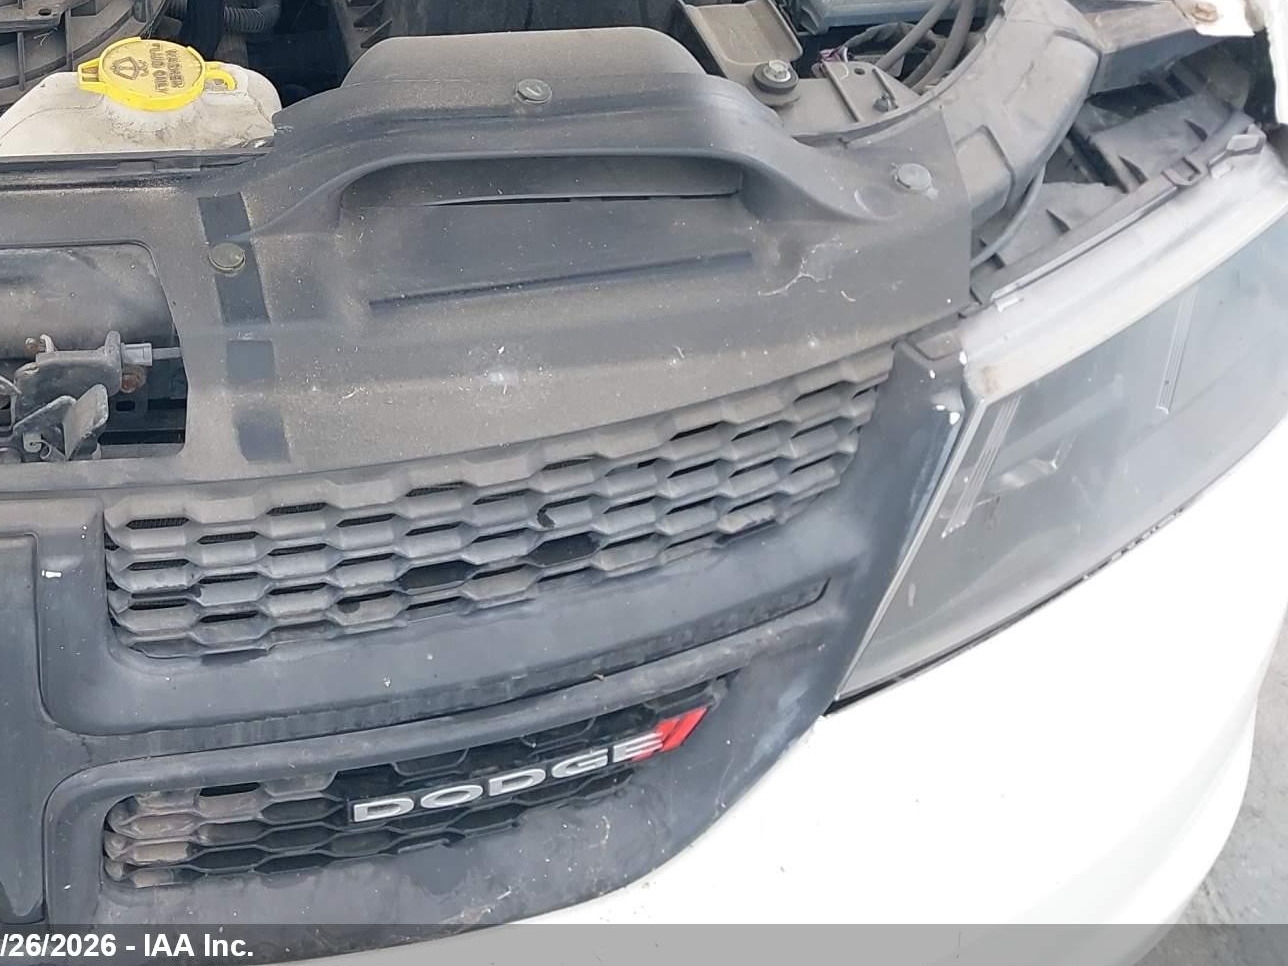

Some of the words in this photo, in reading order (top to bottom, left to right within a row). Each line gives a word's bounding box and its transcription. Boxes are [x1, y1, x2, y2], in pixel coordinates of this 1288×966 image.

[153, 69, 169, 94] ONLY
[165, 48, 185, 89] WASHER
[353, 731, 664, 823] DODGE
